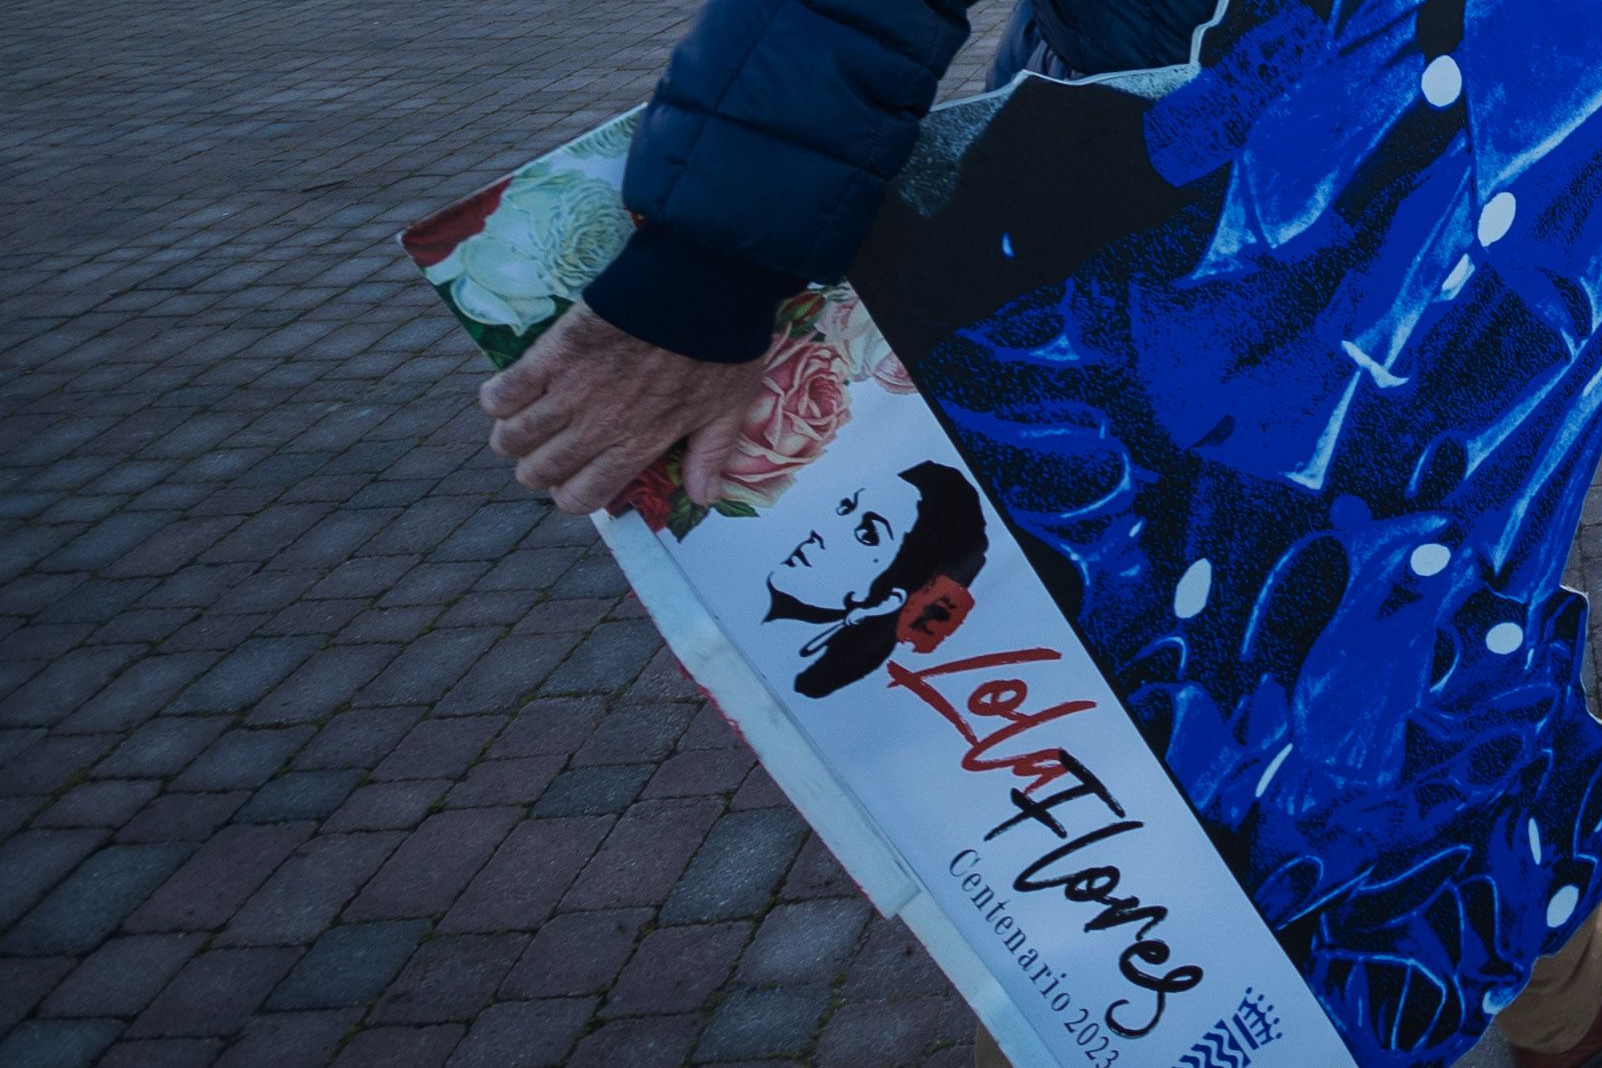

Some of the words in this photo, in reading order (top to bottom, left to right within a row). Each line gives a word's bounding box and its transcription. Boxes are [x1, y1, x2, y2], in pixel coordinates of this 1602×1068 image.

[887, 647, 1097, 796] Lola
[949, 848, 1072, 1014] Centenario
[1064, 1007, 1120, 1068] 2023
[983, 747, 1204, 1040] Flores
